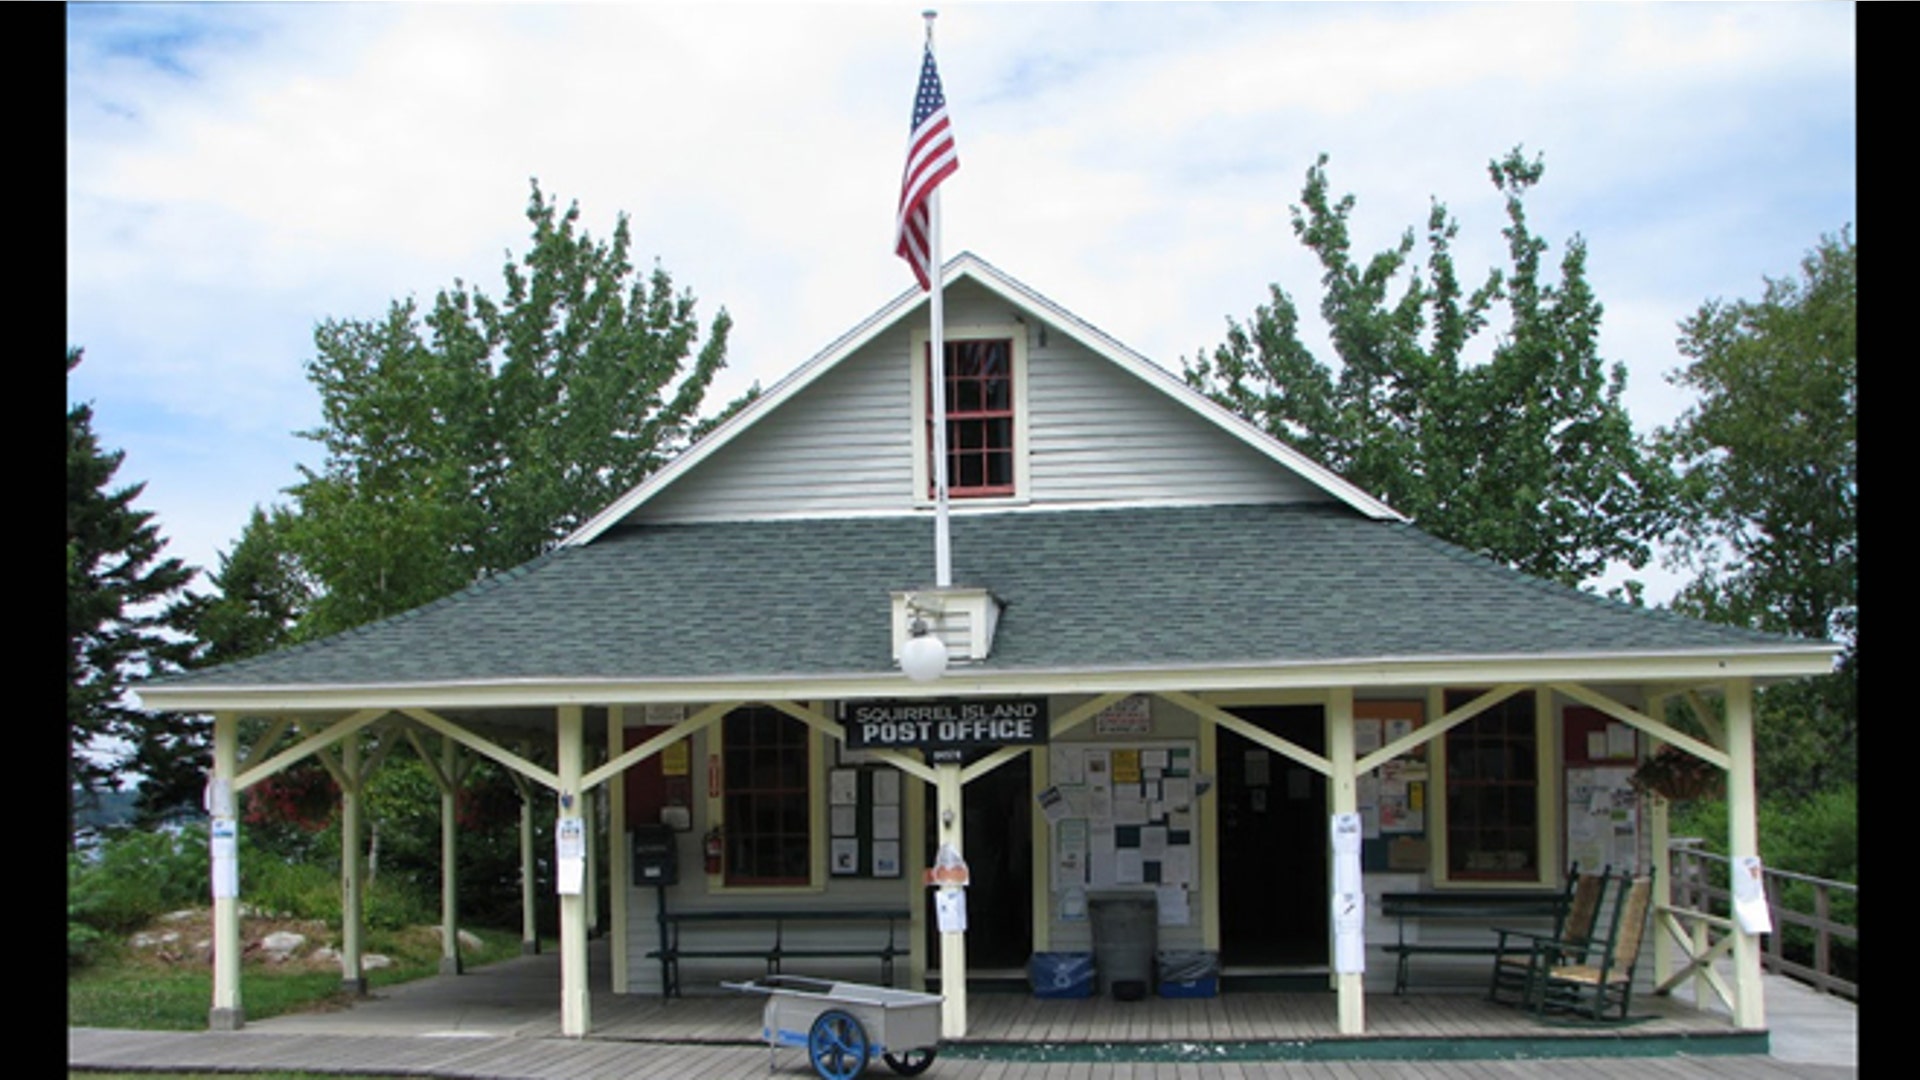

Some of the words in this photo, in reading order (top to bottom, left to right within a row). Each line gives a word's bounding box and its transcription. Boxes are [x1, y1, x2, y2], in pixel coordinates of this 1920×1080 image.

[857, 706, 957, 723] SQUIRREL
[962, 704, 1037, 720] ISLAND
[863, 721, 932, 743] POST
[938, 719, 1033, 741] OFFICE
